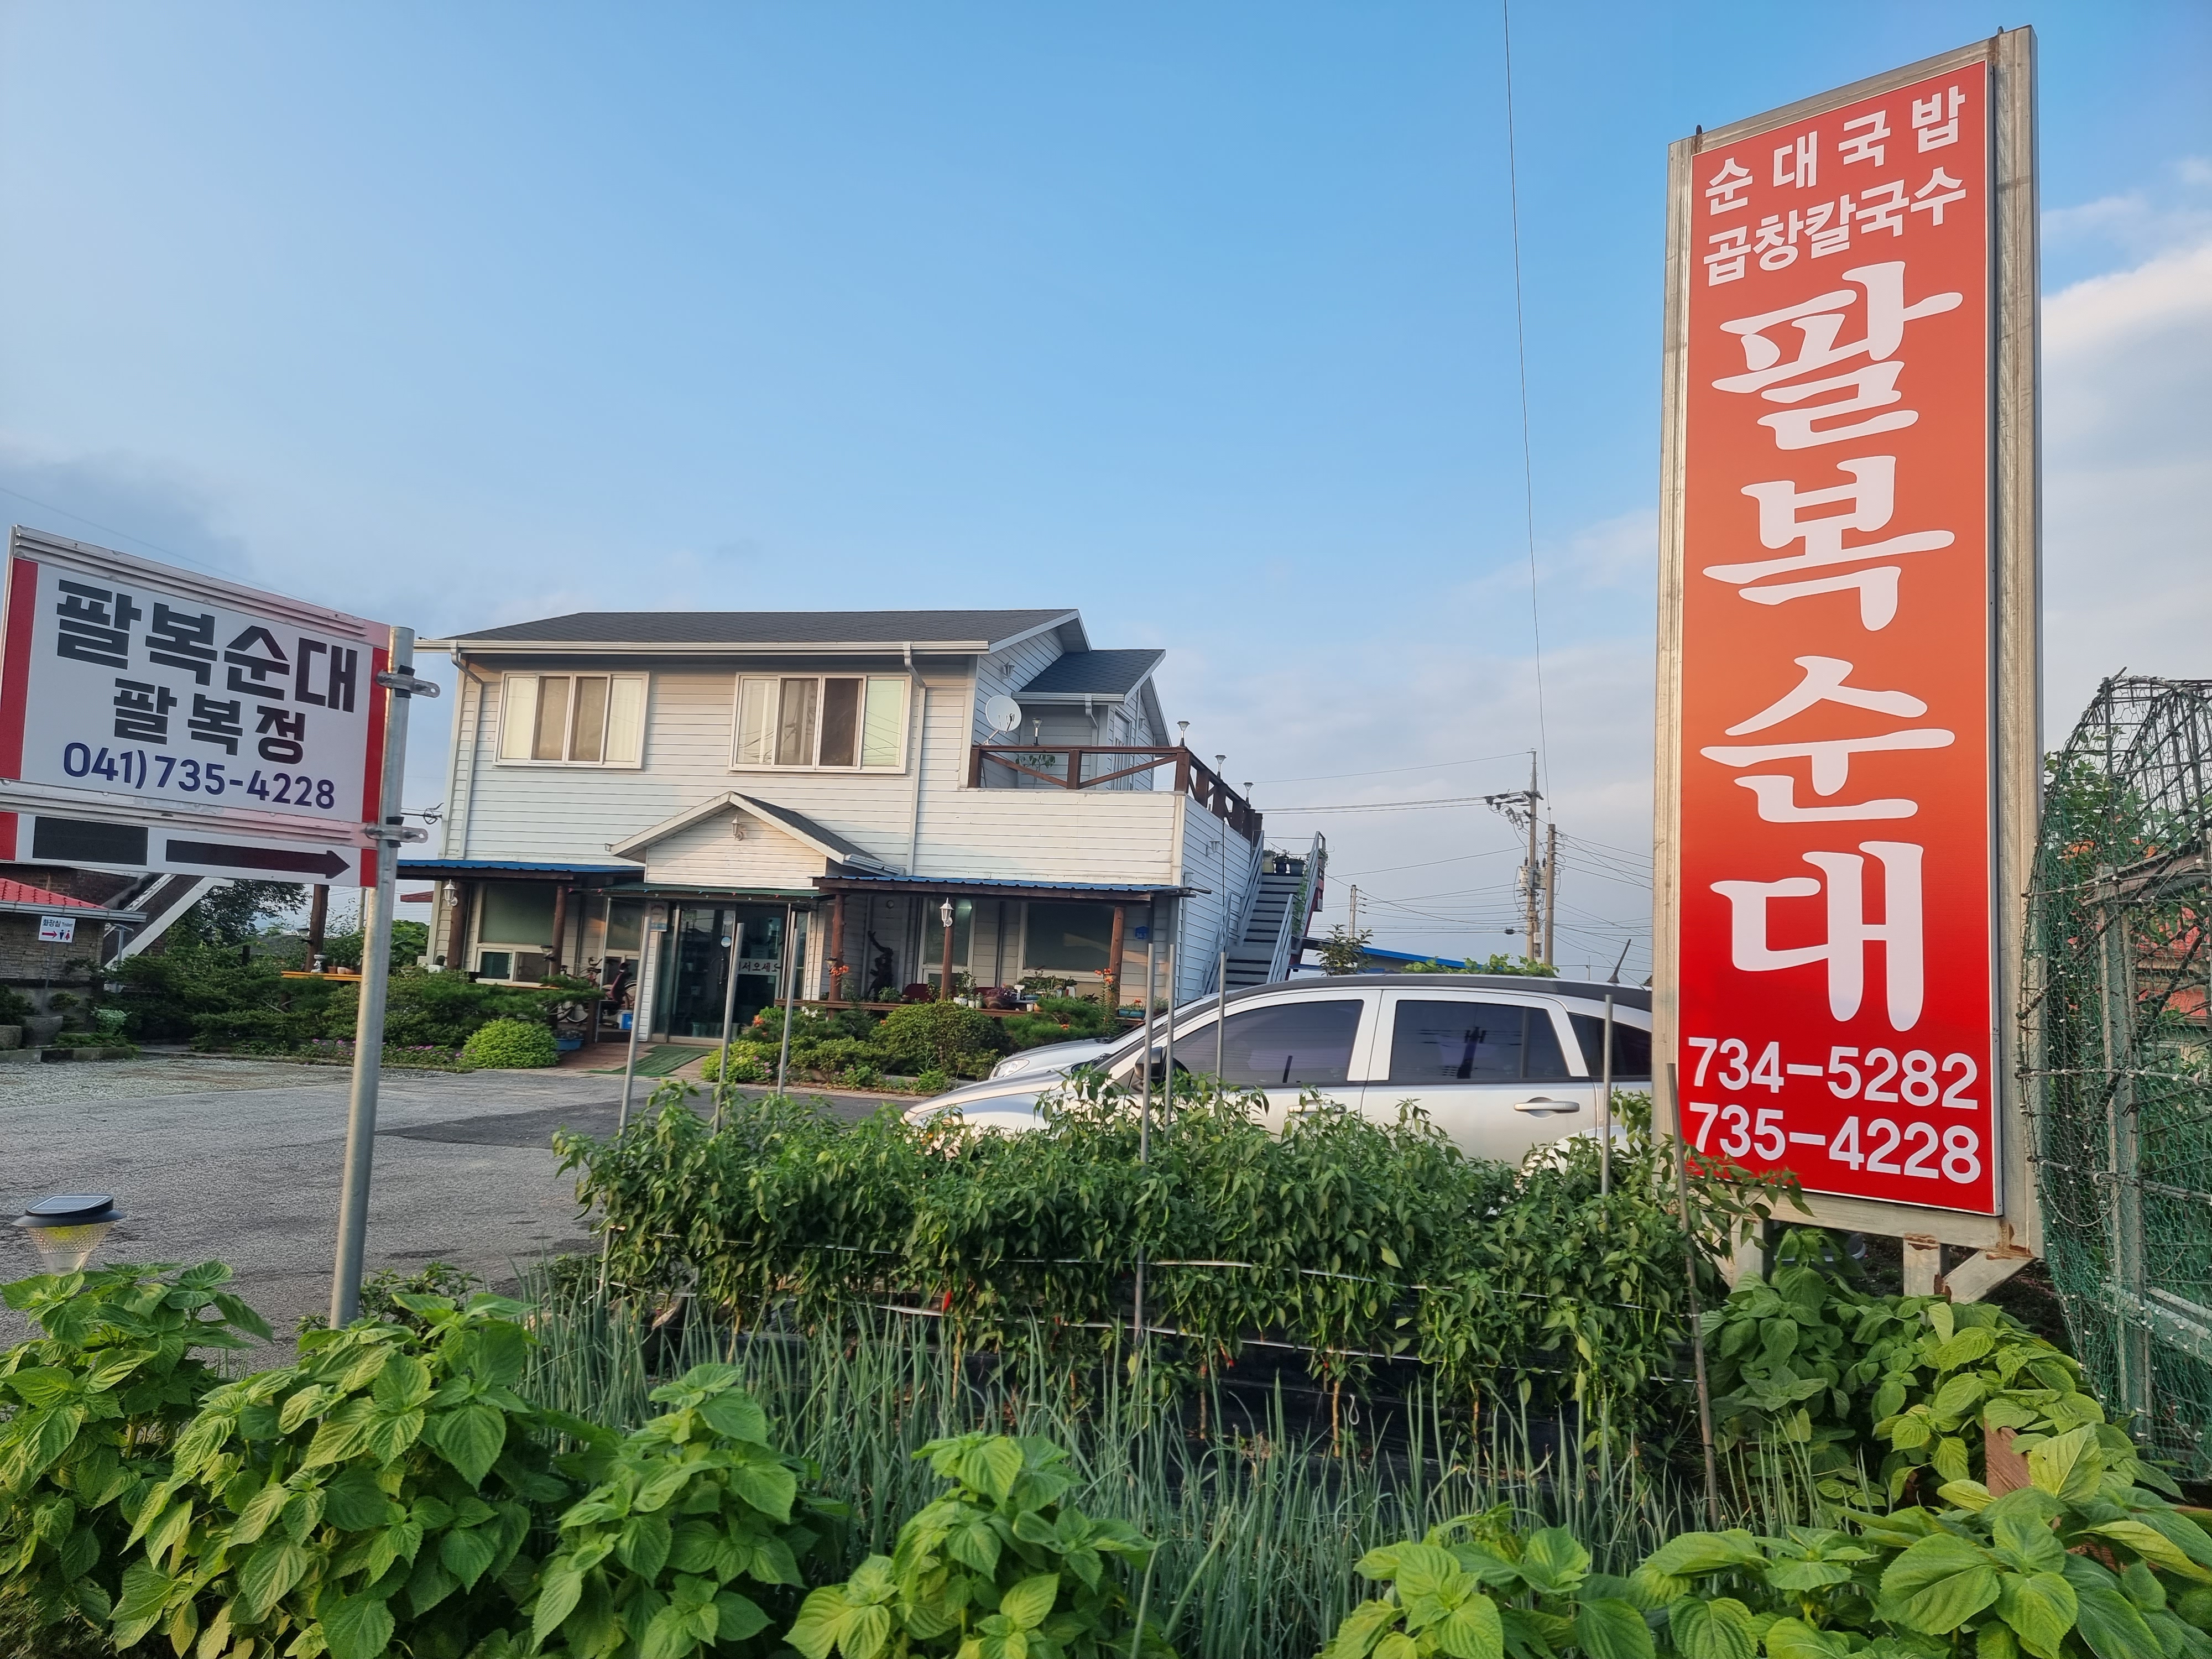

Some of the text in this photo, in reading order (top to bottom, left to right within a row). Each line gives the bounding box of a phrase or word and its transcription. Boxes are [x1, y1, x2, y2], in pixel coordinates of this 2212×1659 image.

[1705, 86, 1965, 216] 순대국밥
[1704, 166, 1966, 287] 곱창칼국수
[56, 579, 358, 713] 팔복순대
[1700, 261, 1963, 1032] 팔복순대
[113, 677, 306, 765] 팔복정
[43, 919, 61, 927] 화장실
[1688, 1037, 1978, 1110] 734-5282
[1688, 1102, 1981, 1184] 735-4228
